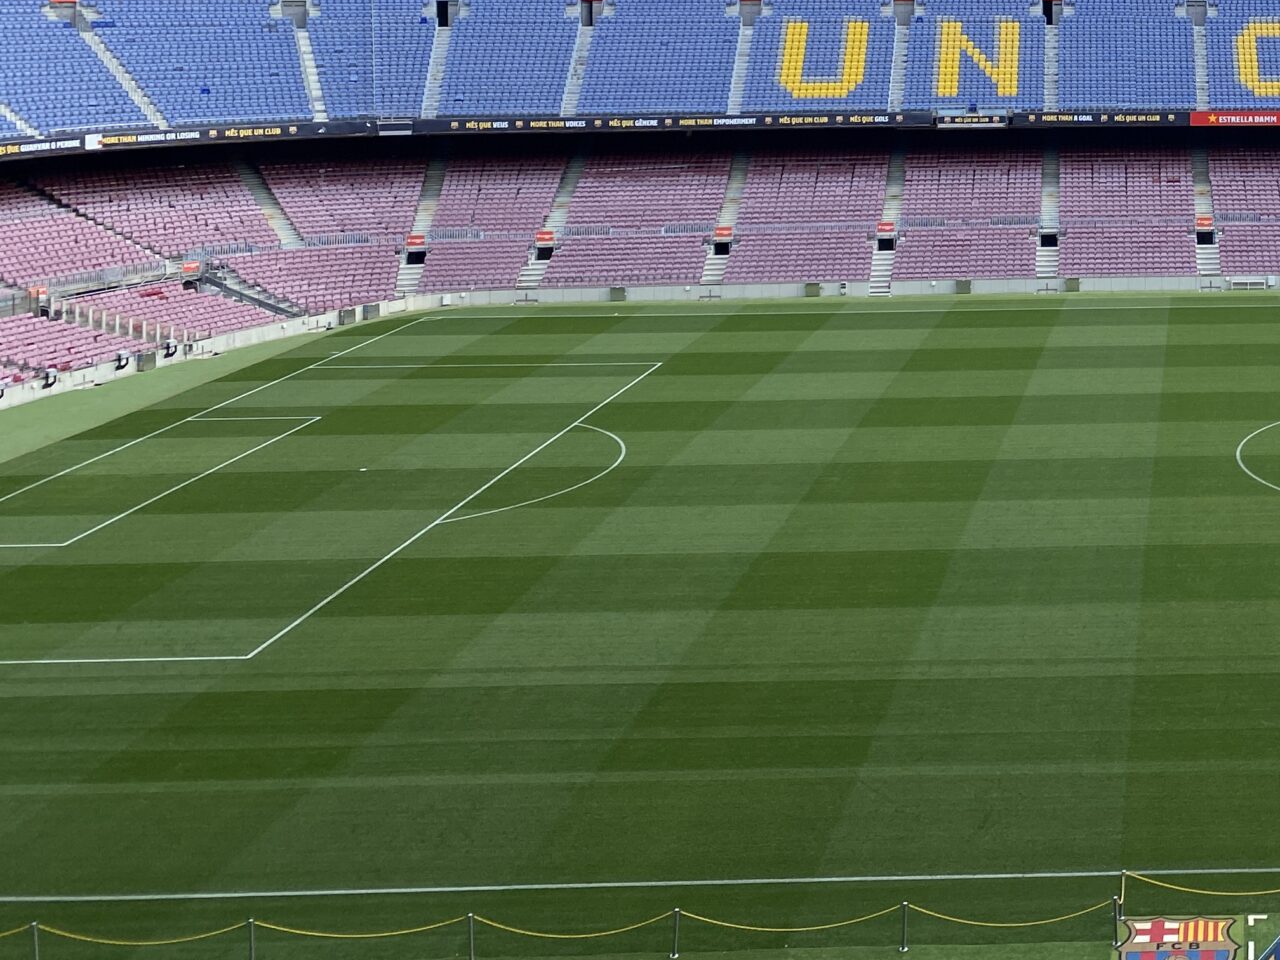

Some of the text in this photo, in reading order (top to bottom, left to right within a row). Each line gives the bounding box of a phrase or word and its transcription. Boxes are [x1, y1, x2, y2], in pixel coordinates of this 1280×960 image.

[776, 16, 1021, 98] UN
[1219, 115, 1277, 123] ESTRELLA DAMM
[225, 128, 238, 137] MÉS
[239, 129, 253, 138] QUE
[265, 127, 281, 135] CLUB
[1156, 942, 1200, 950] FCB
